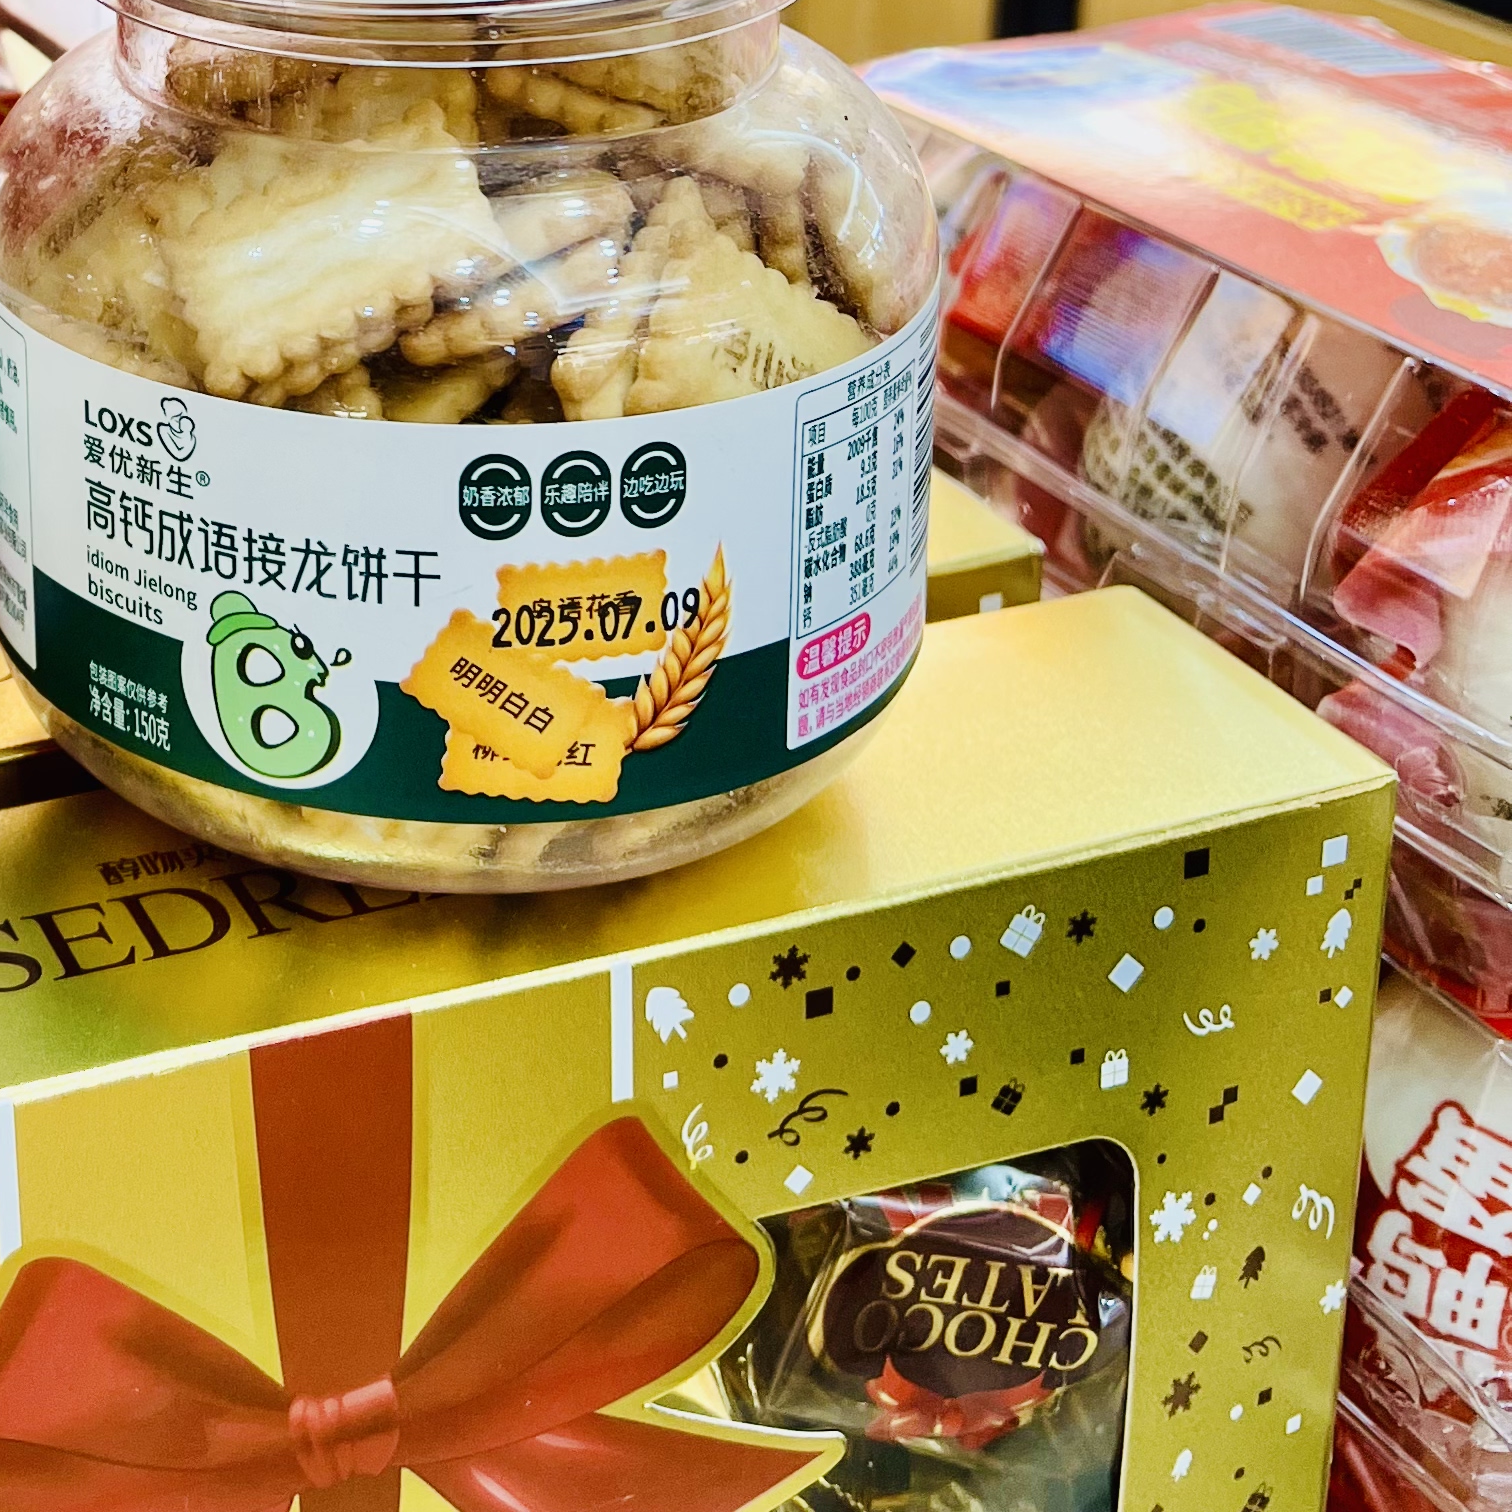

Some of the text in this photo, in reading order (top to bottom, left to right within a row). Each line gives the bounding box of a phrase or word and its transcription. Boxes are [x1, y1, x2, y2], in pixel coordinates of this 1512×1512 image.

[847, 359, 891, 402] 营养成分表
[83, 399, 154, 448] LOXS
[807, 421, 826, 448] 项目
[851, 395, 879, 429] 每100克
[622, 470, 685, 499] 边吃边玩
[805, 472, 834, 505] 蛋白质
[807, 451, 825, 480] 能量
[461, 485, 531, 507] 奶香浓郁
[543, 480, 610, 506] 乐趣陪伴
[805, 502, 824, 531] 脂肪
[85, 478, 442, 608] 高钙成语接龙饼干
[803, 541, 847, 580] 碳水化合物
[86, 544, 198, 612] idiom Jielong
[87, 577, 164, 625] biscuits
[491, 586, 701, 649] 2025.07.09
[802, 617, 868, 676] 温馨提示
[88, 658, 169, 714] 包装图案仅供参考
[449, 655, 555, 735] 明明白白
[852, 1299, 1099, 1372] CHOCO
